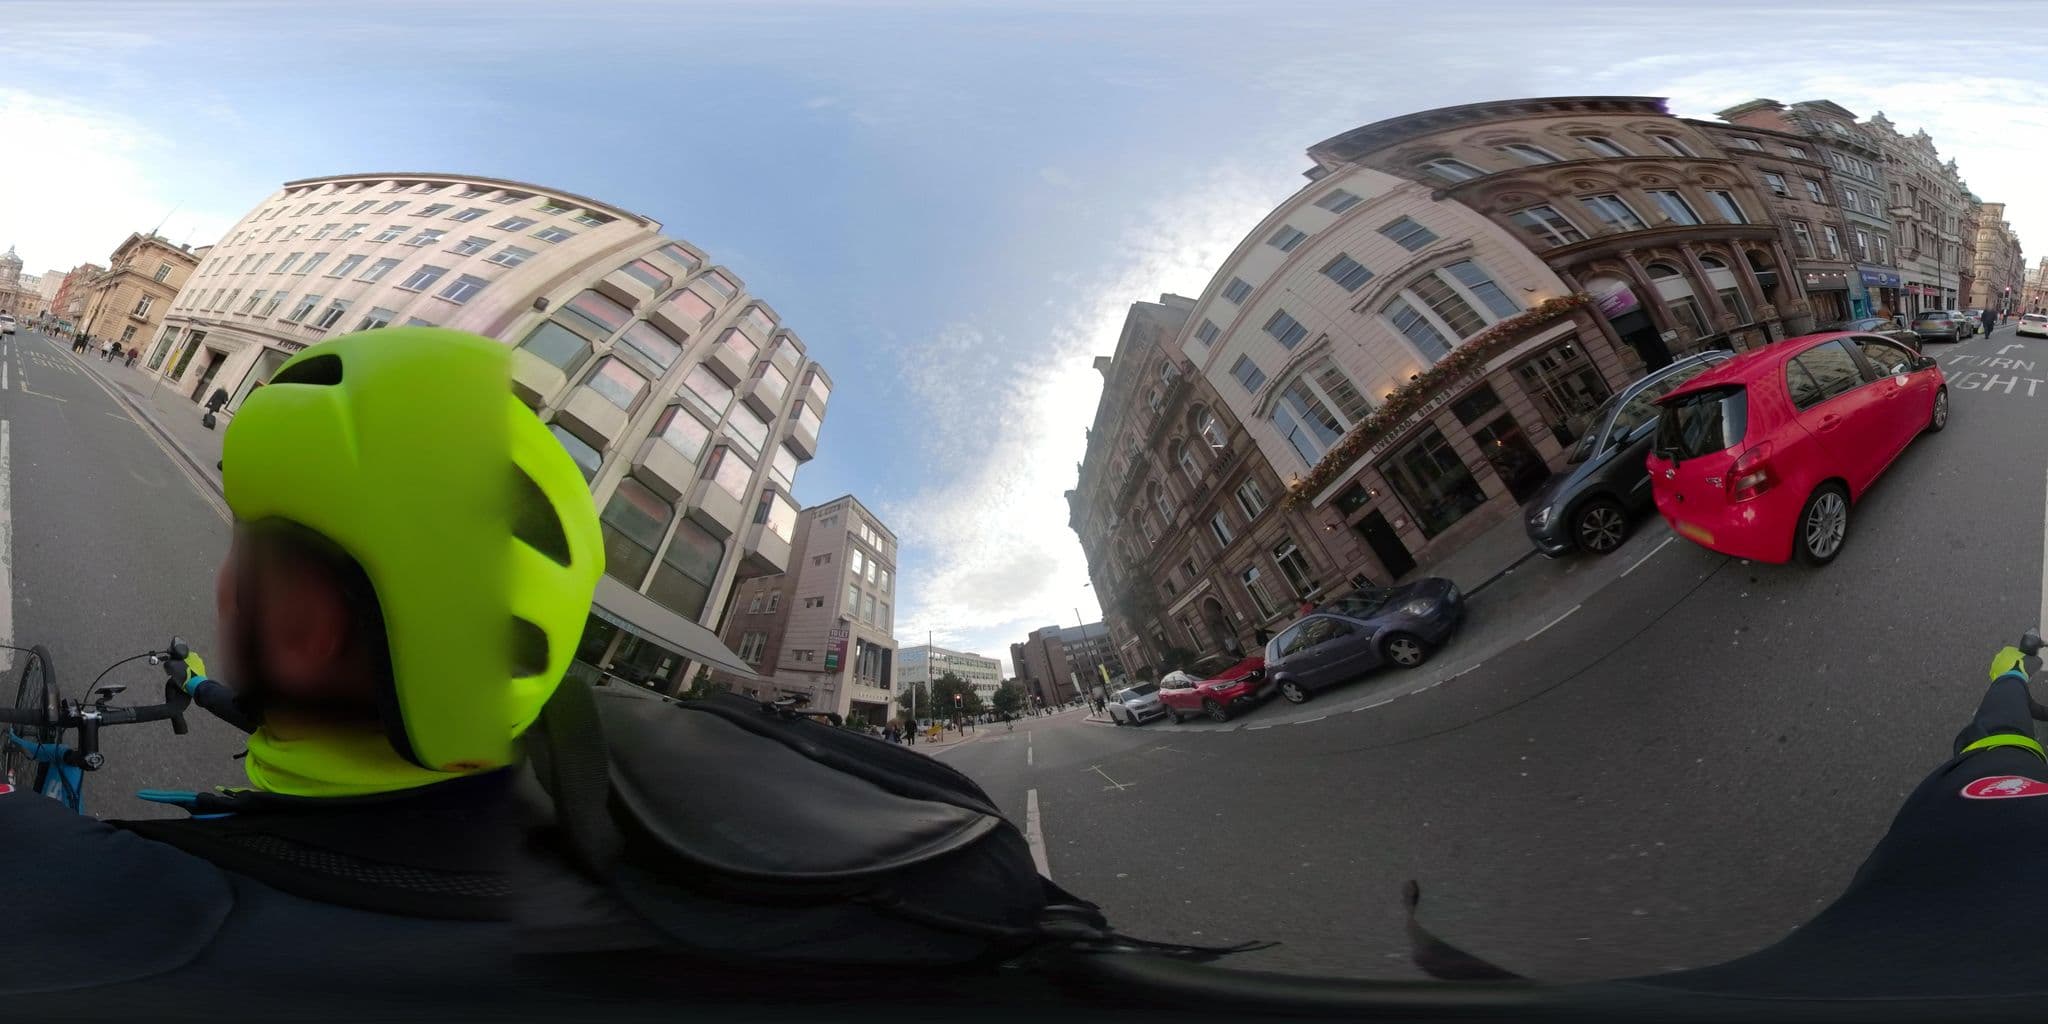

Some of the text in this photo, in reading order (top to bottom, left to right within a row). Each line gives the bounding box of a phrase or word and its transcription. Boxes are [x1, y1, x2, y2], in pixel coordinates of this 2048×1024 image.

[1947, 354, 2036, 371] TURN
[1943, 371, 2045, 397] IGHT
[1371, 366, 1488, 455] LIVERPOOL GIN DISLLRY
